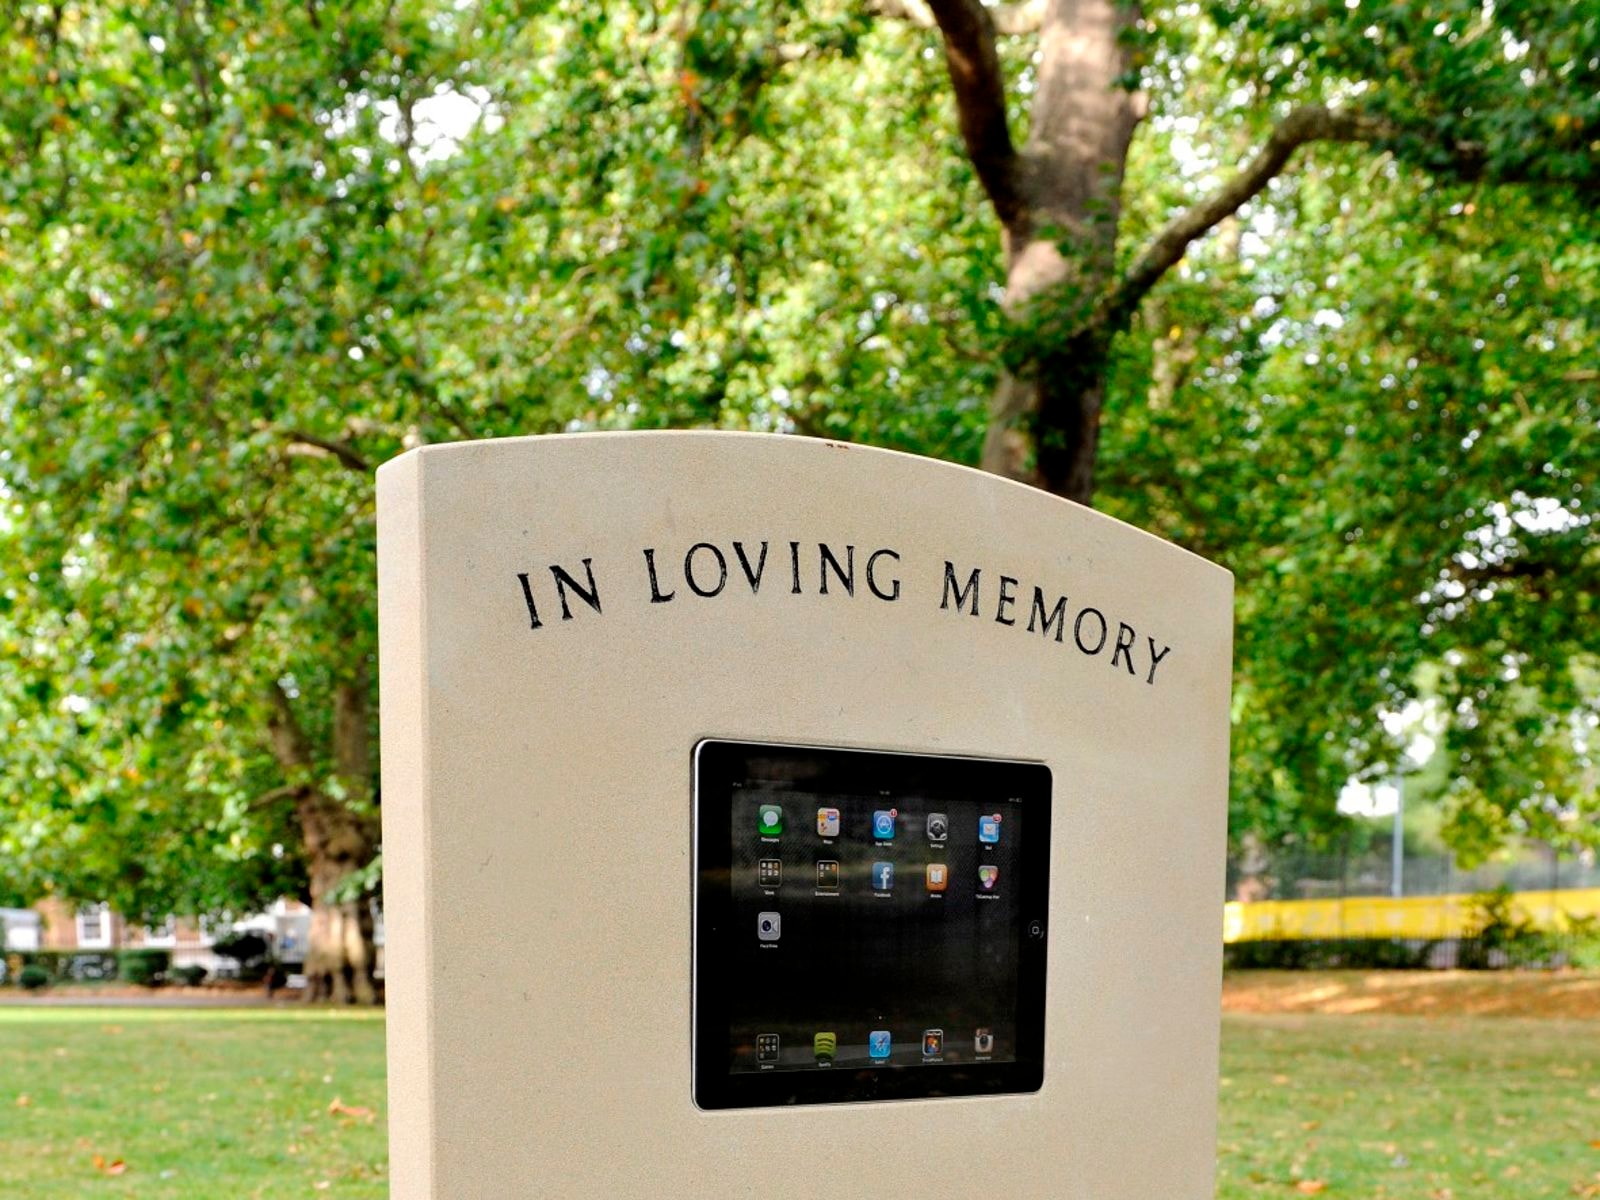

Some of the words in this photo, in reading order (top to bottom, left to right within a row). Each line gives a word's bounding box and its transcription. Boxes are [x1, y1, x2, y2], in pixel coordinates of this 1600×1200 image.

[516, 557, 602, 630] IN
[643, 541, 901, 604] LOVING
[939, 560, 1171, 685] MEMORY
